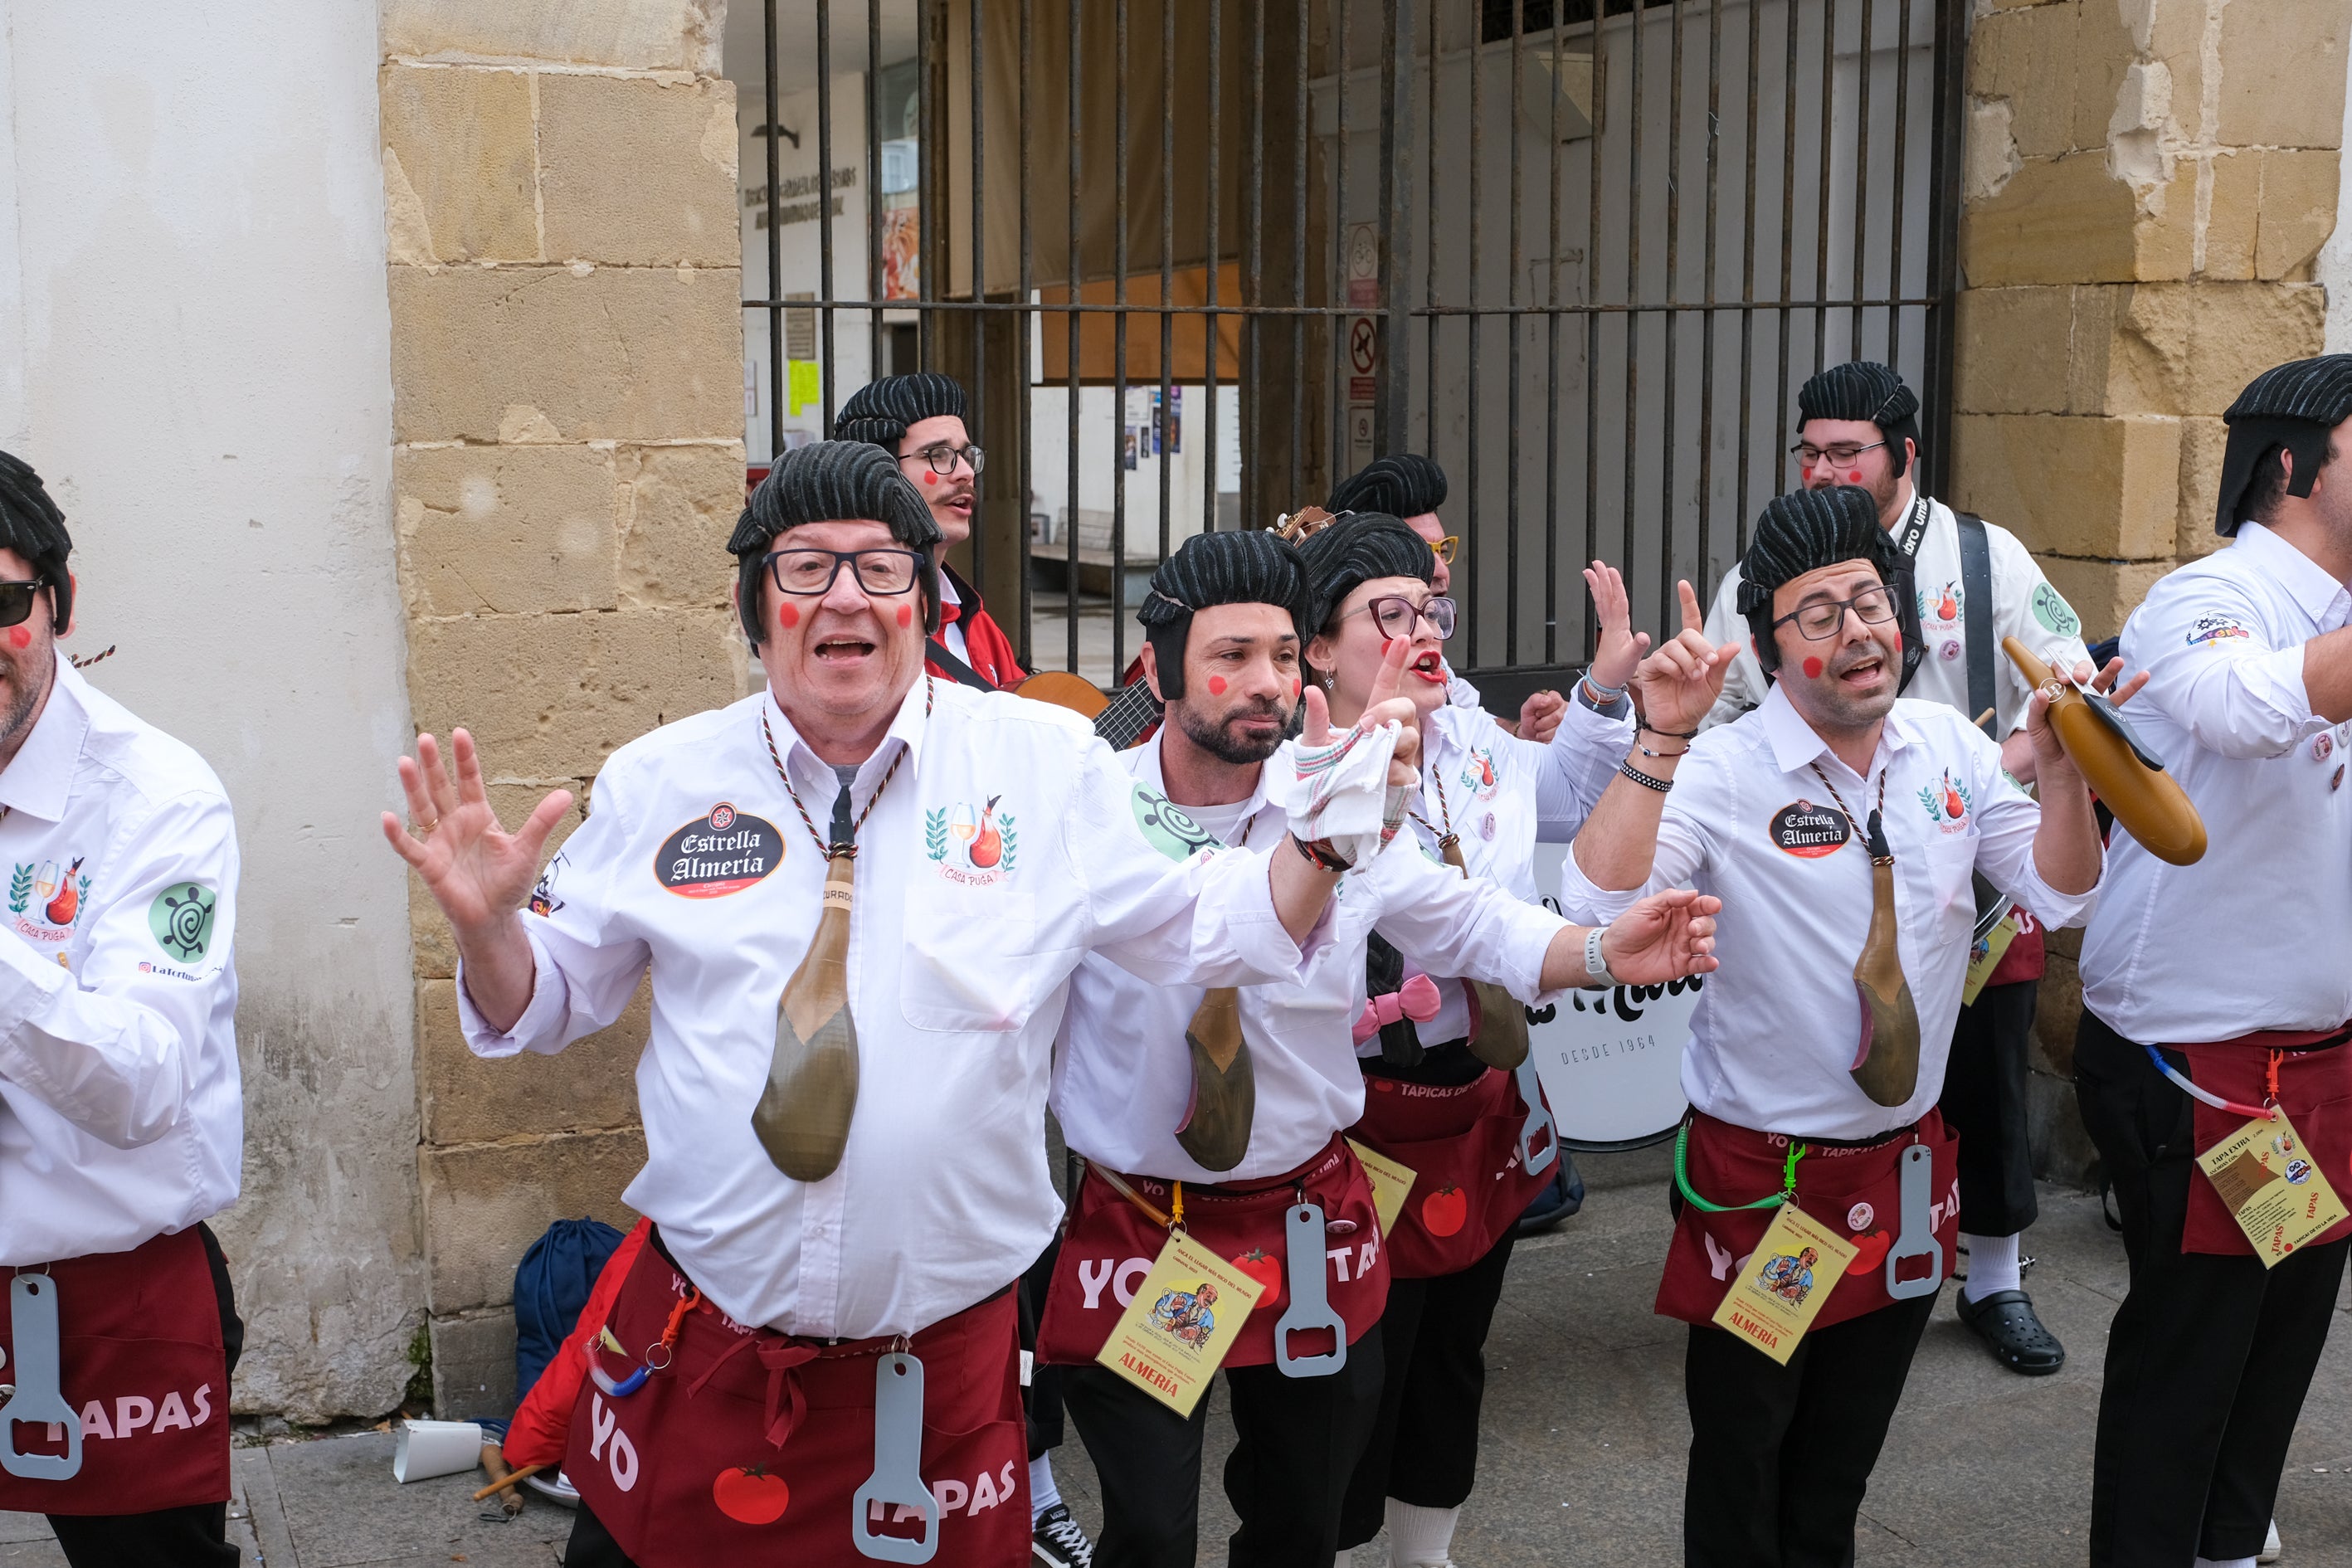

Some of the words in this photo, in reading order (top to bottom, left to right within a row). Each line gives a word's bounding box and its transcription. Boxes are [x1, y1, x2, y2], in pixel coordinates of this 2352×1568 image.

[1782, 825, 1843, 845] Almería
[1785, 814, 1835, 828] Estrella
[680, 830, 762, 854] Estrella
[670, 850, 764, 882] Almería
[945, 869, 965, 884] CASA
[968, 874, 994, 885] PUGA
[20, 923, 39, 938] CASA
[41, 931, 66, 941] PUGA
[1561, 1044, 1610, 1065] DESDE
[1619, 1035, 1655, 1054] 1964
[1401, 1083, 1453, 1098] TAPICAS
[1766, 1132, 1789, 1148] YO
[2212, 1152, 2229, 1165] TAPA
[2228, 1137, 2250, 1154] EXTRA
[1142, 1180, 1165, 1195] YO
[2306, 1192, 2319, 1220] TAPAS
[2326, 1214, 2337, 1222] VIDA
[2272, 1225, 2284, 1253] TAPAS
[1079, 1257, 1155, 1309] YO
[1176, 1248, 1188, 1257] ANCA
[1193, 1259, 1208, 1270] LUGAR
[1207, 1267, 1218, 1276] MÁS
[1216, 1273, 1228, 1283] RICO
[1235, 1286, 1252, 1298] MUNDO
[1728, 1311, 1779, 1349] ALMERÍA
[1118, 1352, 1178, 1398] ALMERÍA
[590, 1392, 639, 1492] YO
